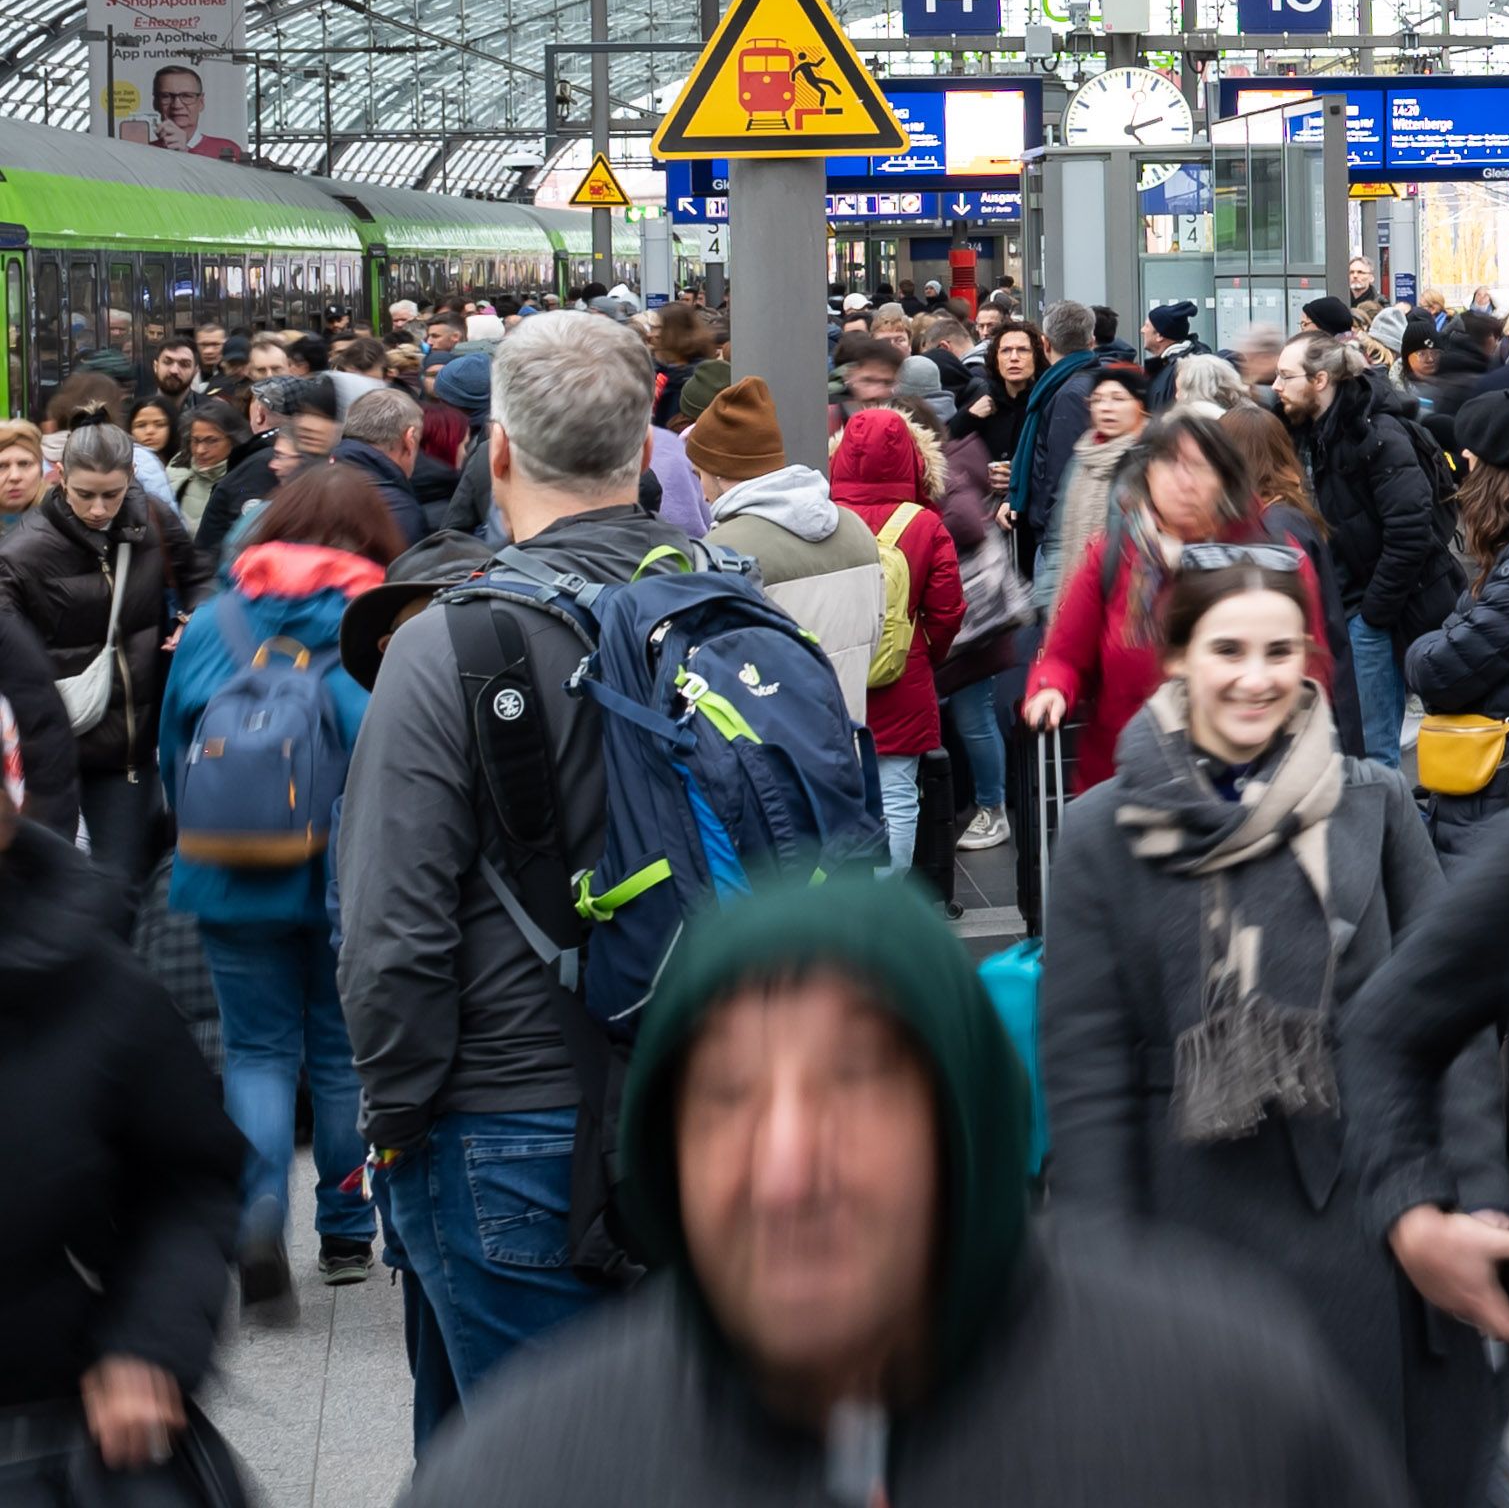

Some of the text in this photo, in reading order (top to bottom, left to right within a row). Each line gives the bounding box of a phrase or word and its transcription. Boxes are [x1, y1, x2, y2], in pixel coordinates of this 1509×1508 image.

[134, 16, 200, 30] E-Rezept?
[154, 31, 217, 44] Apotheke
[1392, 105, 1419, 117] 14:20
[1392, 117, 1453, 133] Wittenberge
[1187, 226, 1198, 243] 4
[707, 237, 720, 255] 4
